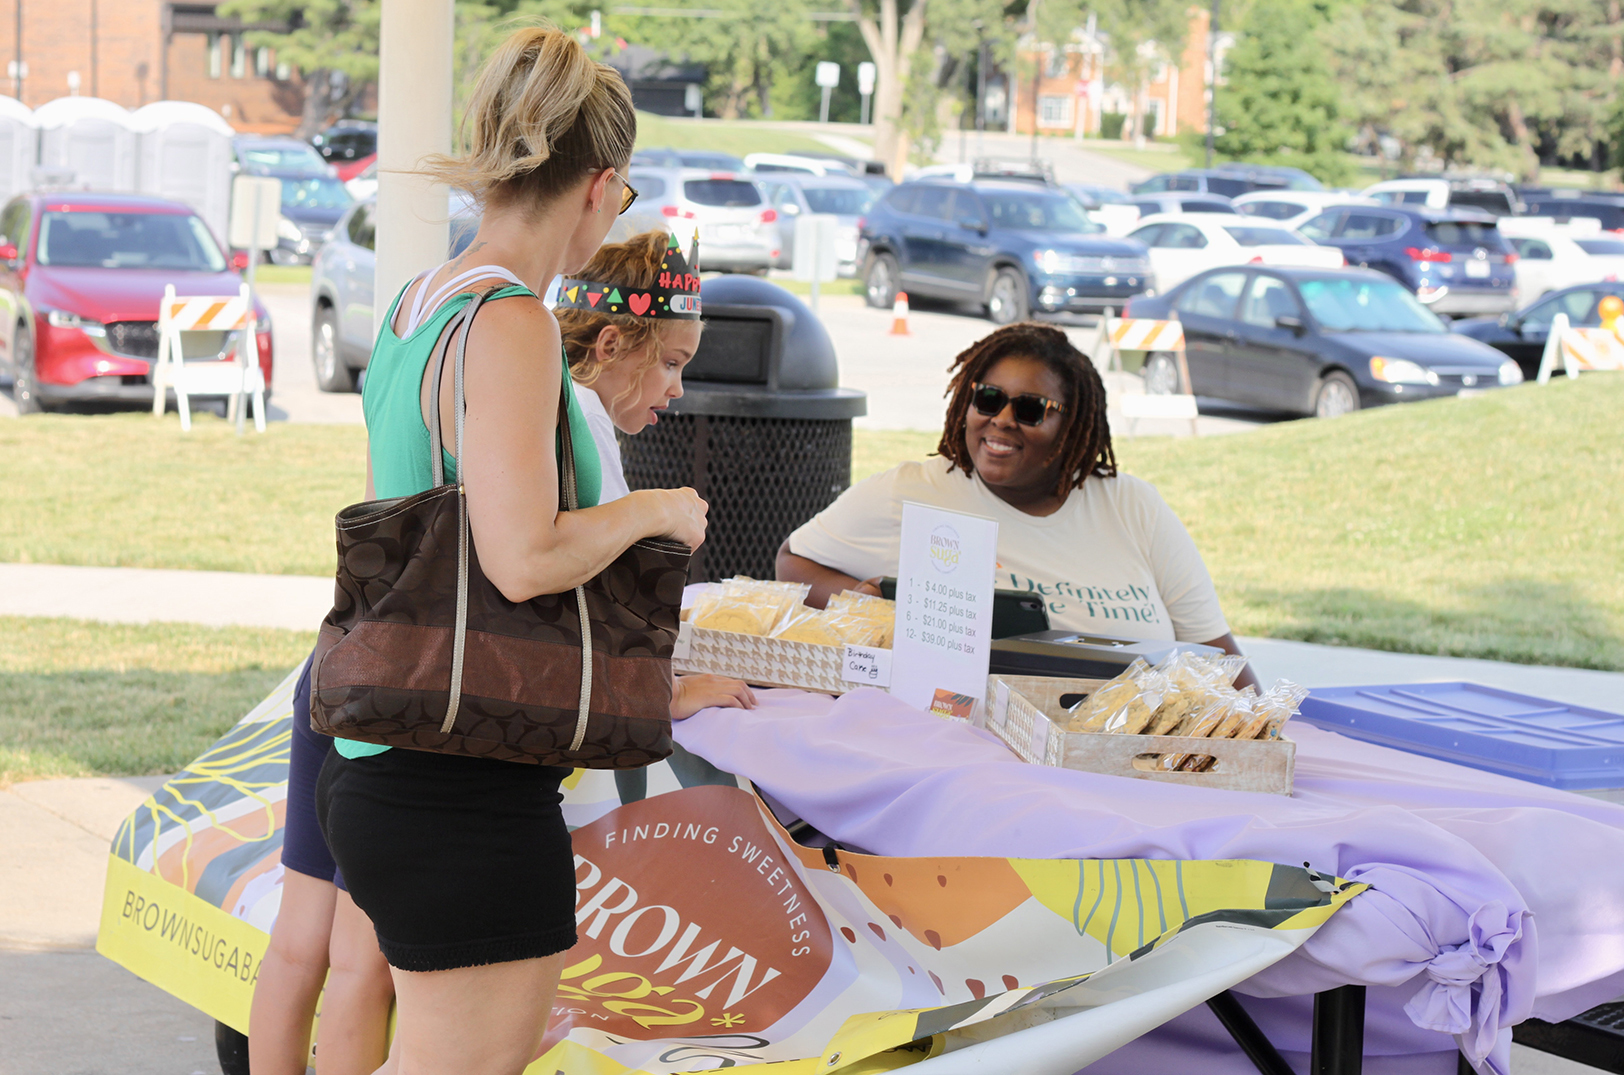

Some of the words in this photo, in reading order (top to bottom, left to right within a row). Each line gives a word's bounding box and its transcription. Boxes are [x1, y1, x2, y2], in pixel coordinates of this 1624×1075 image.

[930, 534, 960, 550] BROWN
[910, 578, 913, 587] 1
[949, 588, 964, 599] plus
[966, 591, 976, 602] tax
[1010, 574, 1150, 604] Definitely
[908, 594, 912, 604] 3
[924, 598, 947, 613] $11.25
[949, 605, 964, 617] plus
[966, 609, 976, 620] tax
[1080, 602, 1160, 624] Time!
[906, 611, 911, 621] 6
[923, 614, 947, 630] $21.00
[949, 622, 963, 634] plus
[965, 626, 976, 637] tax
[921, 631, 946, 647] $39.00
[947, 639, 962, 651] plus
[964, 643, 975, 654] tax
[604, 822, 720, 849] FINDING
[728, 836, 810, 957] SWEETNESS
